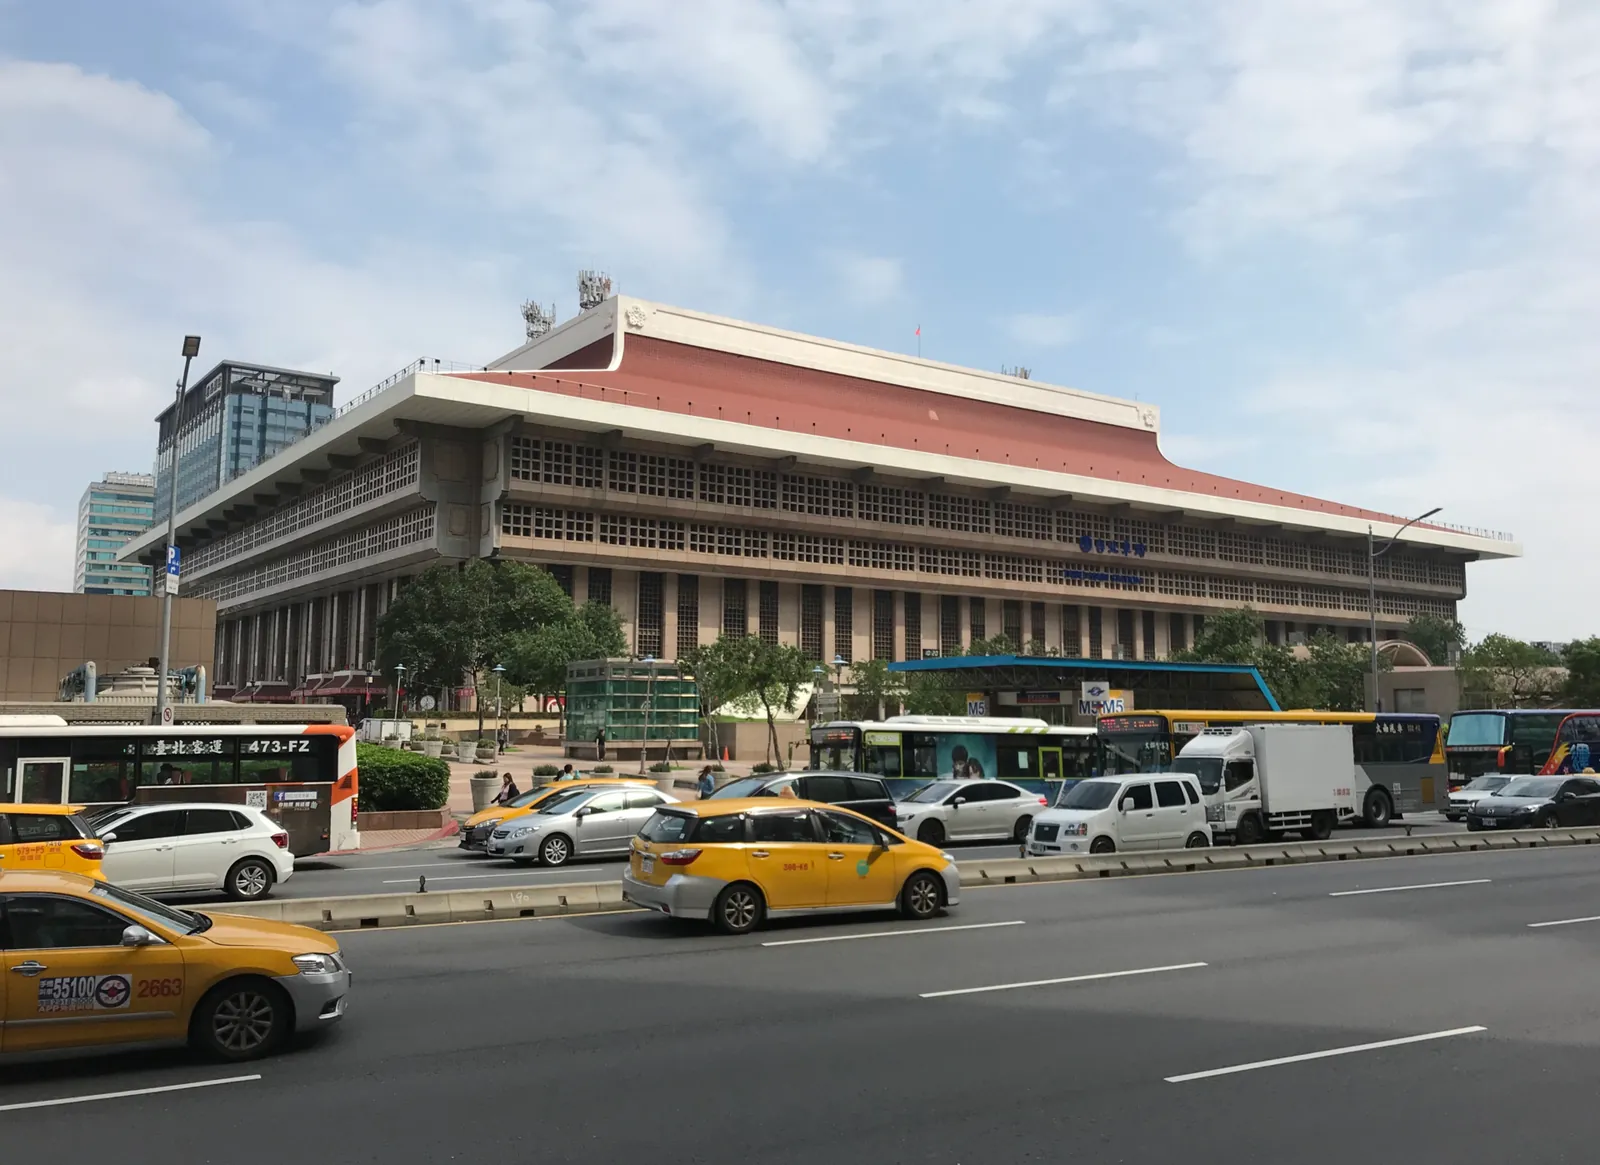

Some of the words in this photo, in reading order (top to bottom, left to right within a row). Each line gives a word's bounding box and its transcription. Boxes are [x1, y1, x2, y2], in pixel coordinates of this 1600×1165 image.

[168, 547, 176, 564] P
[968, 701, 985, 716] M5
[1102, 699, 1124, 714] M5
[153, 739, 223, 756] 臺北客運
[249, 740, 310, 753] 473-FZ
[53, 976, 95, 999] 55100
[137, 979, 183, 998] 2663
